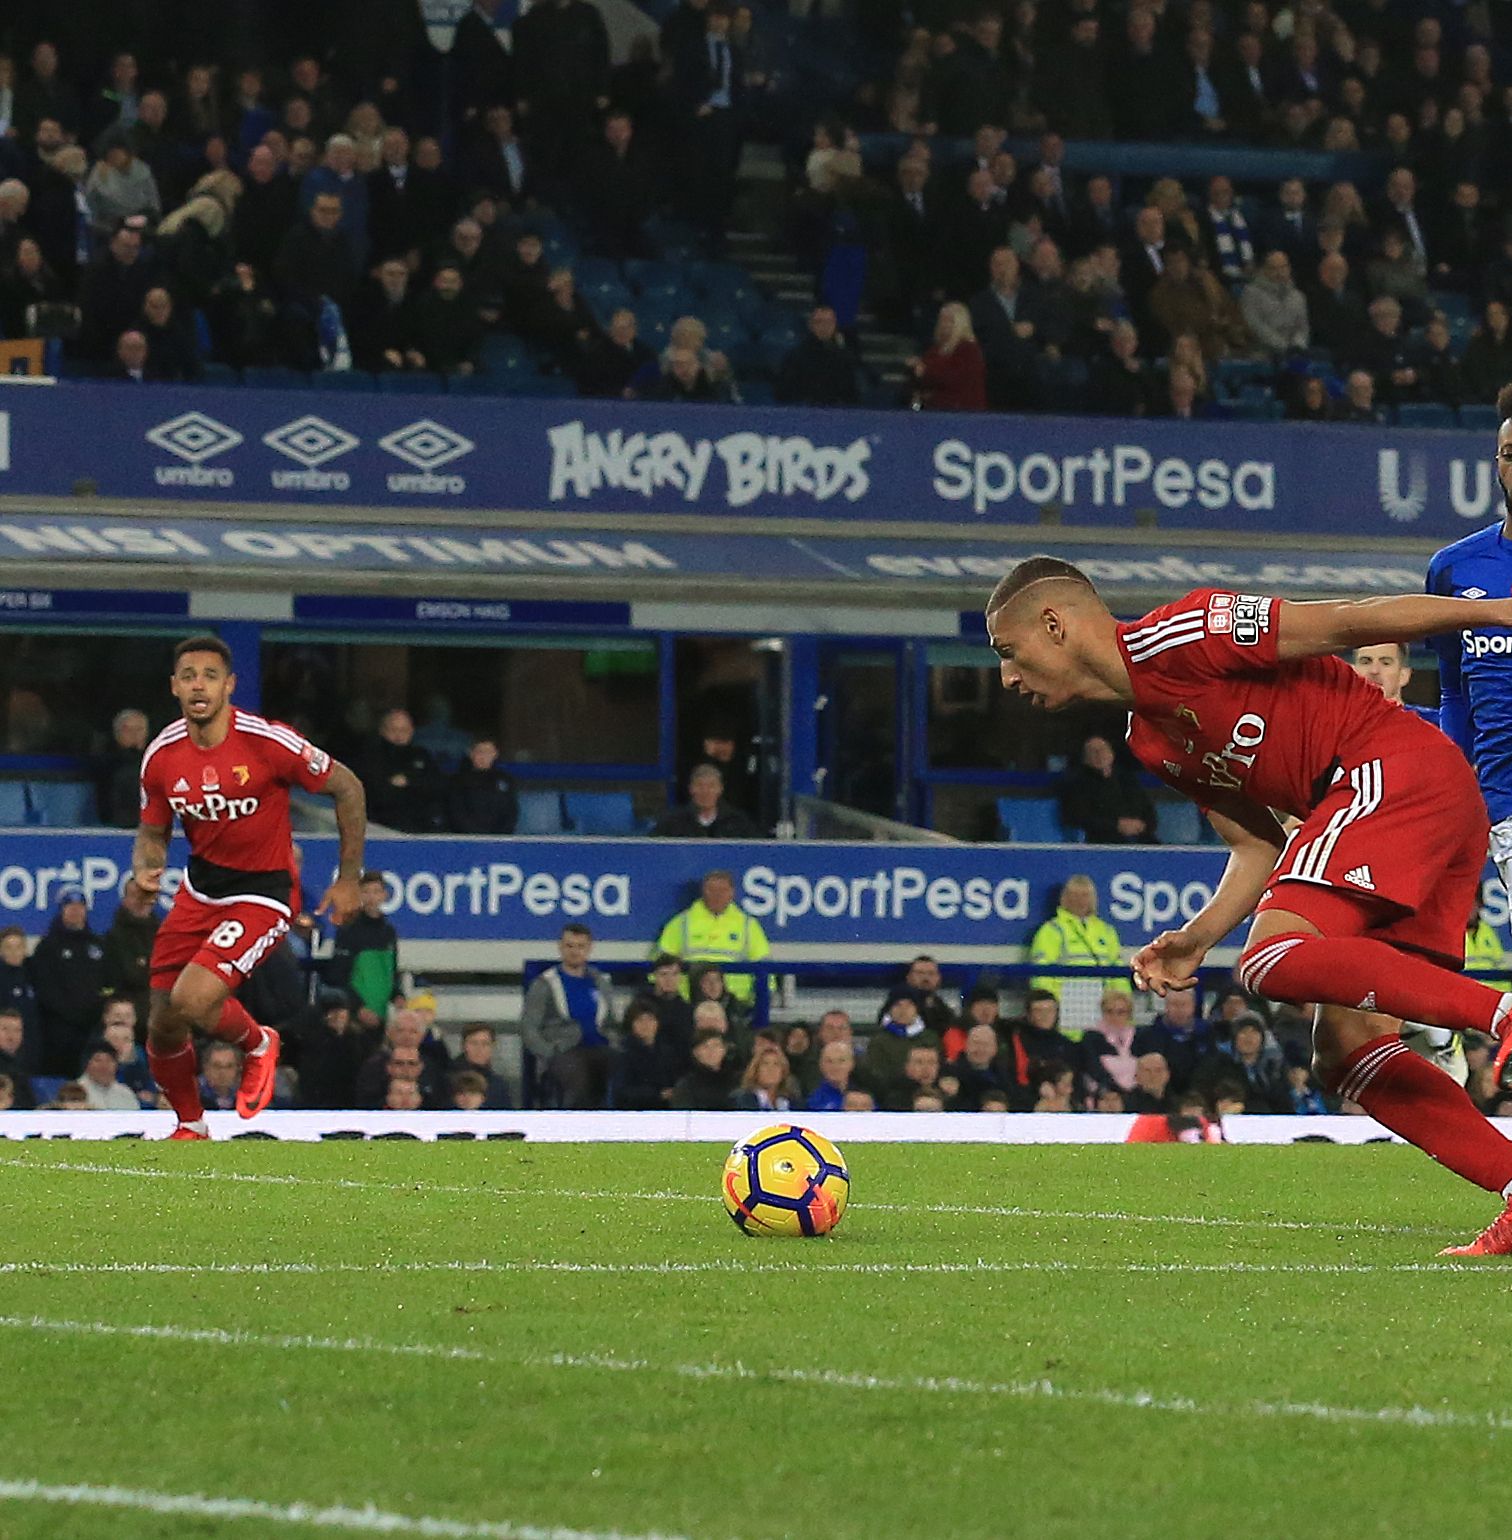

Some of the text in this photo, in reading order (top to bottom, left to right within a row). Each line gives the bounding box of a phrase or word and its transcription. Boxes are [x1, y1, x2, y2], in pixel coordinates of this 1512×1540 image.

[155, 466, 234, 488] umbro
[271, 470, 350, 491] umbro
[387, 473, 467, 494] umbro
[932, 438, 1275, 514] SportPesa
[221, 530, 677, 569] OPTIMUM
[168, 793, 260, 821] FxPro
[743, 866, 1030, 927] SportPesa
